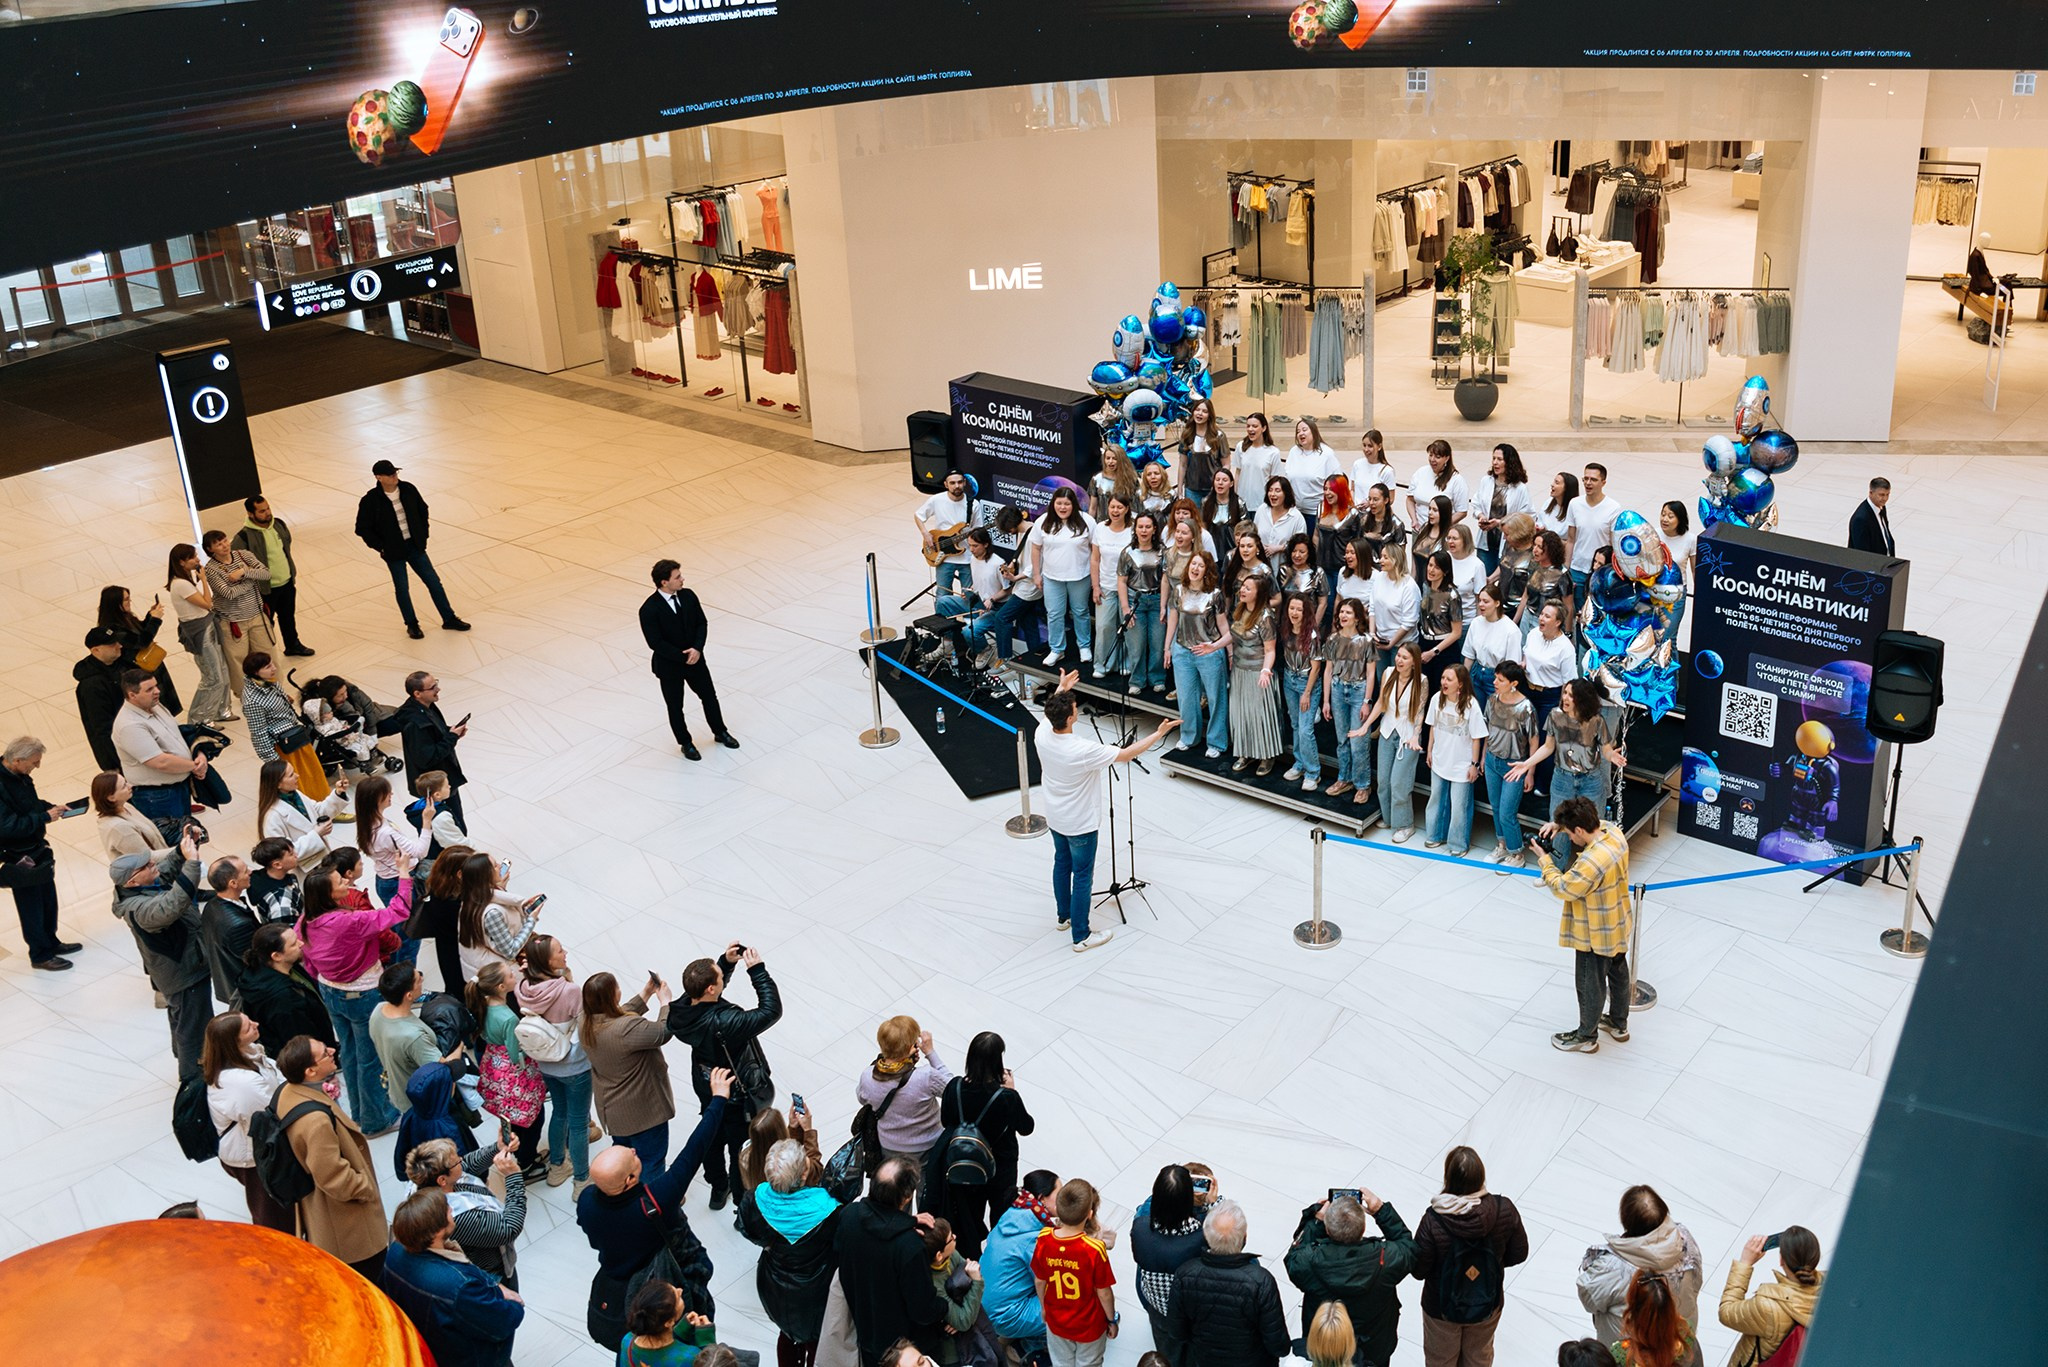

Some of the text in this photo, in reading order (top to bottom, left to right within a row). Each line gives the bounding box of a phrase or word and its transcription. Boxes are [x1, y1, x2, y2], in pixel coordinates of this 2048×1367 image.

[649, 10, 741, 29] ТОРГОВО-РАЗВЛЕКАТЕЛЬНЫЙ
[741, 7, 778, 19] КОМПЛЕКС
[1609, 49, 1649, 57] ПРОДЛИТСЯ
[1794, 50, 1819, 58] АКЦИИ
[1831, 49, 1852, 57] САЙТЕ
[685, 100, 724, 113] ПРОДЛИТСЯ
[724, 99, 729, 107] С
[730, 98, 739, 106] 06
[739, 94, 764, 104] АПРЕЛЯ
[765, 92, 775, 100] ПО
[775, 91, 784, 99] 30
[812, 80, 860, 94] ПОДРОБНОСТИ
[861, 78, 884, 88] АКЦИИ
[885, 77, 894, 85] НА
[895, 75, 916, 84] САЙТЕ
[406, 263, 434, 275] ПРОСПЕКТ
[292, 284, 333, 298] LOVE REPUBLIC
[359, 276, 369, 293] 1
[988, 402, 1033, 422] С ДНЁМ
[962, 412, 1062, 444] КОСМОНАВТИКИ!
[971, 439, 988, 448] ЧЕСТЬ
[988, 443, 1015, 454] 65-ЛЕТИЯ
[1023, 450, 1035, 459] ДНЯ
[1035, 453, 1060, 464] ПЕРВОГО
[981, 433, 1044, 453] ХОРОВОЙ ПЕРФОРМАНС
[974, 446, 996, 457] ПОЛЁТА
[996, 452, 1024, 464] ЧЕЛОВЕКА
[1029, 459, 1053, 469] КОСМОС
[997, 481, 1031, 495] СКАНИРУЙТЕ
[998, 489, 1051, 506] ЧТОБЫ ПЕТЬ ВМЕСТ
[1756, 564, 1826, 592] С ДНЁМ
[1712, 574, 1869, 623] КОСМОНАВТИКИ!
[1715, 606, 1861, 646] В ЧЕСТЬ 65-ЛЕТИЯ СО ДНЯ ПЕРВОГО
[1739, 602, 1838, 631] ХОРОВОЙ ПЕРФОРМАНС
[1726, 617, 1758, 632] ПОЛЁТА
[1759, 625, 1803, 642] ЧЕЛОВЕКА
[1810, 637, 1849, 652] КОСМОС
[1755, 662, 1846, 691] СКАНИРУЙТЕ QR-КОД,
[1757, 671, 1843, 698] ЧТОБЫ ПЕТЬ ВМЕСТЕ
[1780, 686, 1816, 701] С НАМИ!
[1700, 768, 1760, 789] ПОДПИСЫВАЙТЕСЬ
[1049, 1270, 1080, 1300] 19
